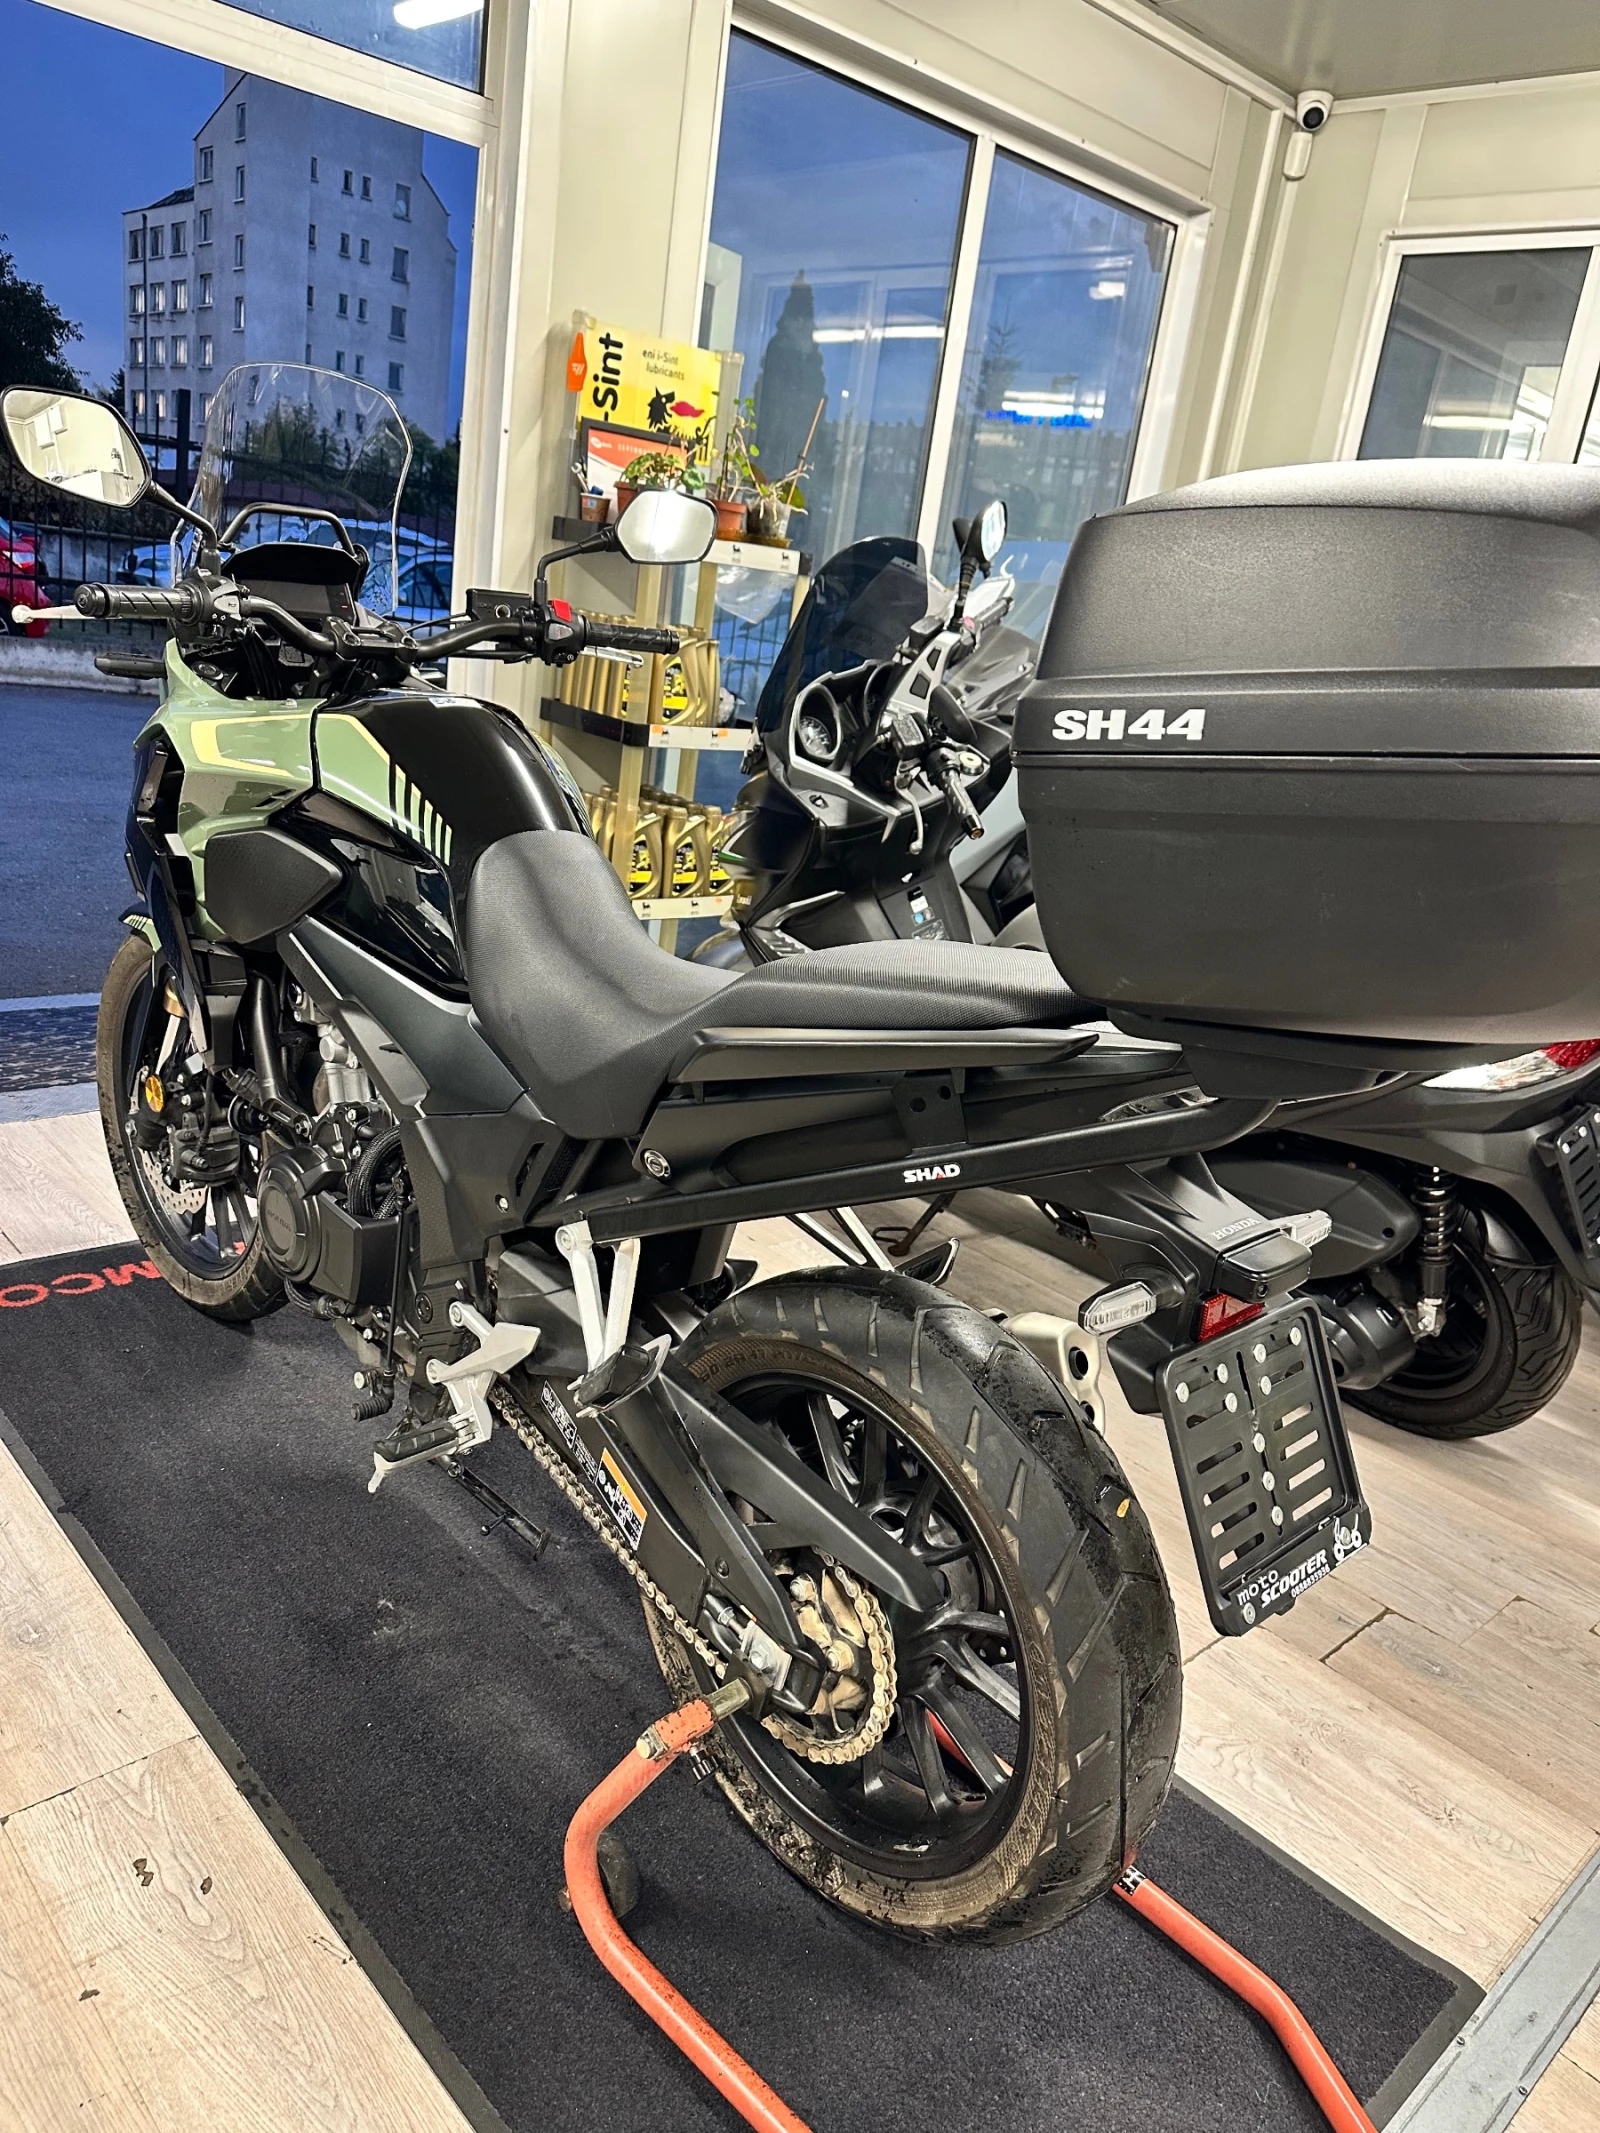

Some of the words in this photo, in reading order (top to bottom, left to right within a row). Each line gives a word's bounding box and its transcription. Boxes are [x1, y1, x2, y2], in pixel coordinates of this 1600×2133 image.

[642, 349, 656, 360] eni
[645, 361, 685, 380] lubricants
[1052, 708, 1206, 741] SH44
[903, 1163, 961, 1183] SHAD
[1212, 1217, 1261, 1240] HONDA
[1237, 1569, 1279, 1606] moto
[1260, 1549, 1329, 1609] SCOOTER
